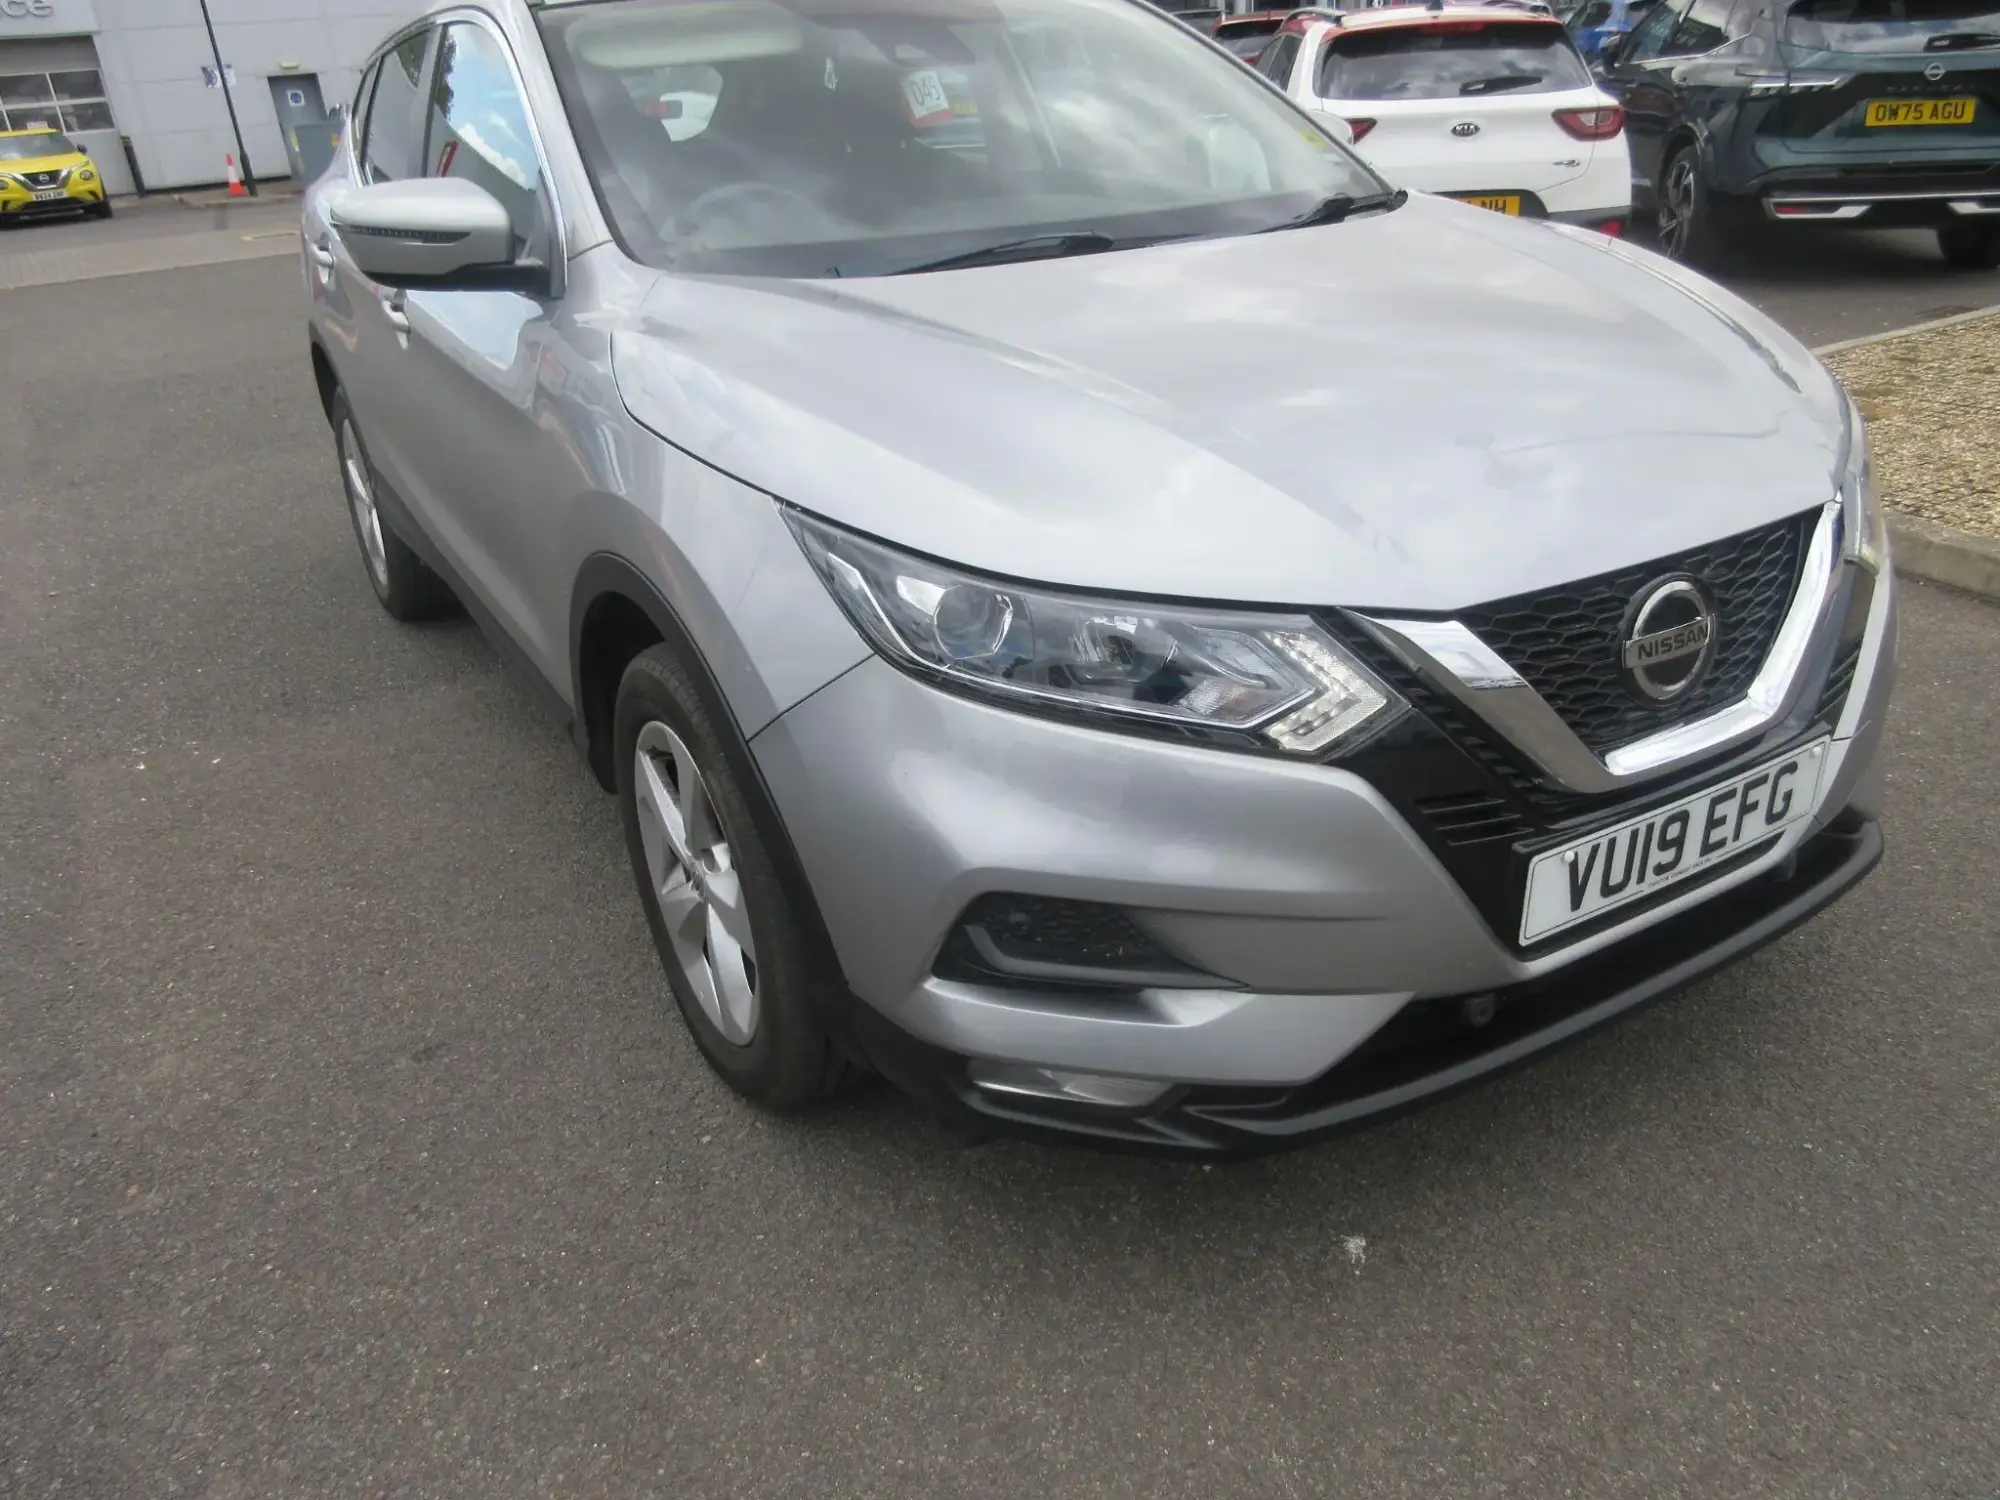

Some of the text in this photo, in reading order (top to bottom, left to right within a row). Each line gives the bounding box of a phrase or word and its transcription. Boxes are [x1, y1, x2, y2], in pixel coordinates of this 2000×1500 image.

[908, 75, 941, 107] 045
[1874, 101, 1967, 122] OW75 AGU
[1454, 124, 1477, 136] KIA
[1638, 624, 1708, 660] NISSAN
[1568, 760, 1798, 912] VU19 EFG
